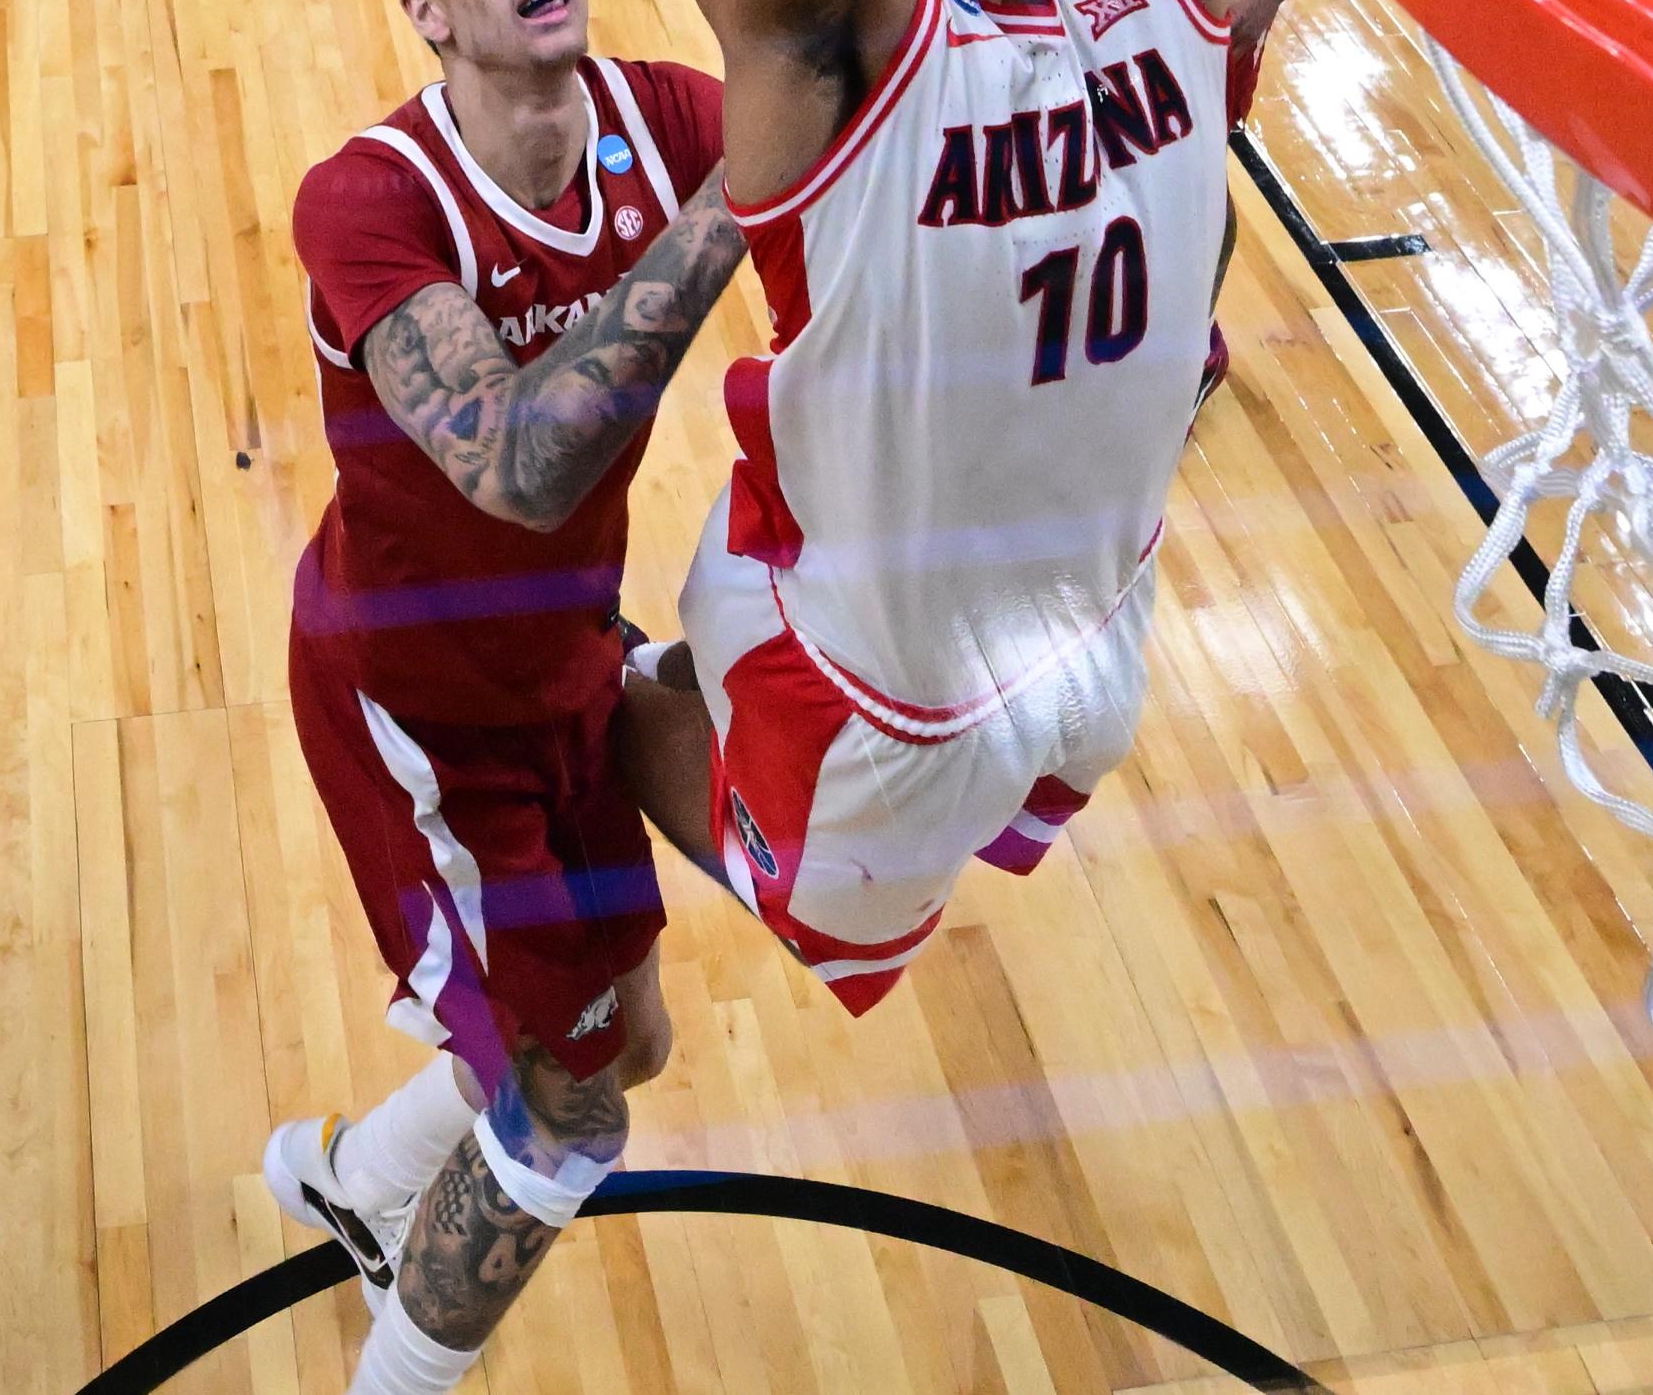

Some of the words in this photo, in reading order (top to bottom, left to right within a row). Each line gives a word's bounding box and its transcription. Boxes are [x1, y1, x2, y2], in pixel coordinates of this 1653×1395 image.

[604, 148, 632, 168] NCAA
[917, 47, 1194, 227] ARIZNA
[616, 208, 642, 238] SEC
[1017, 214, 1149, 387] 10
